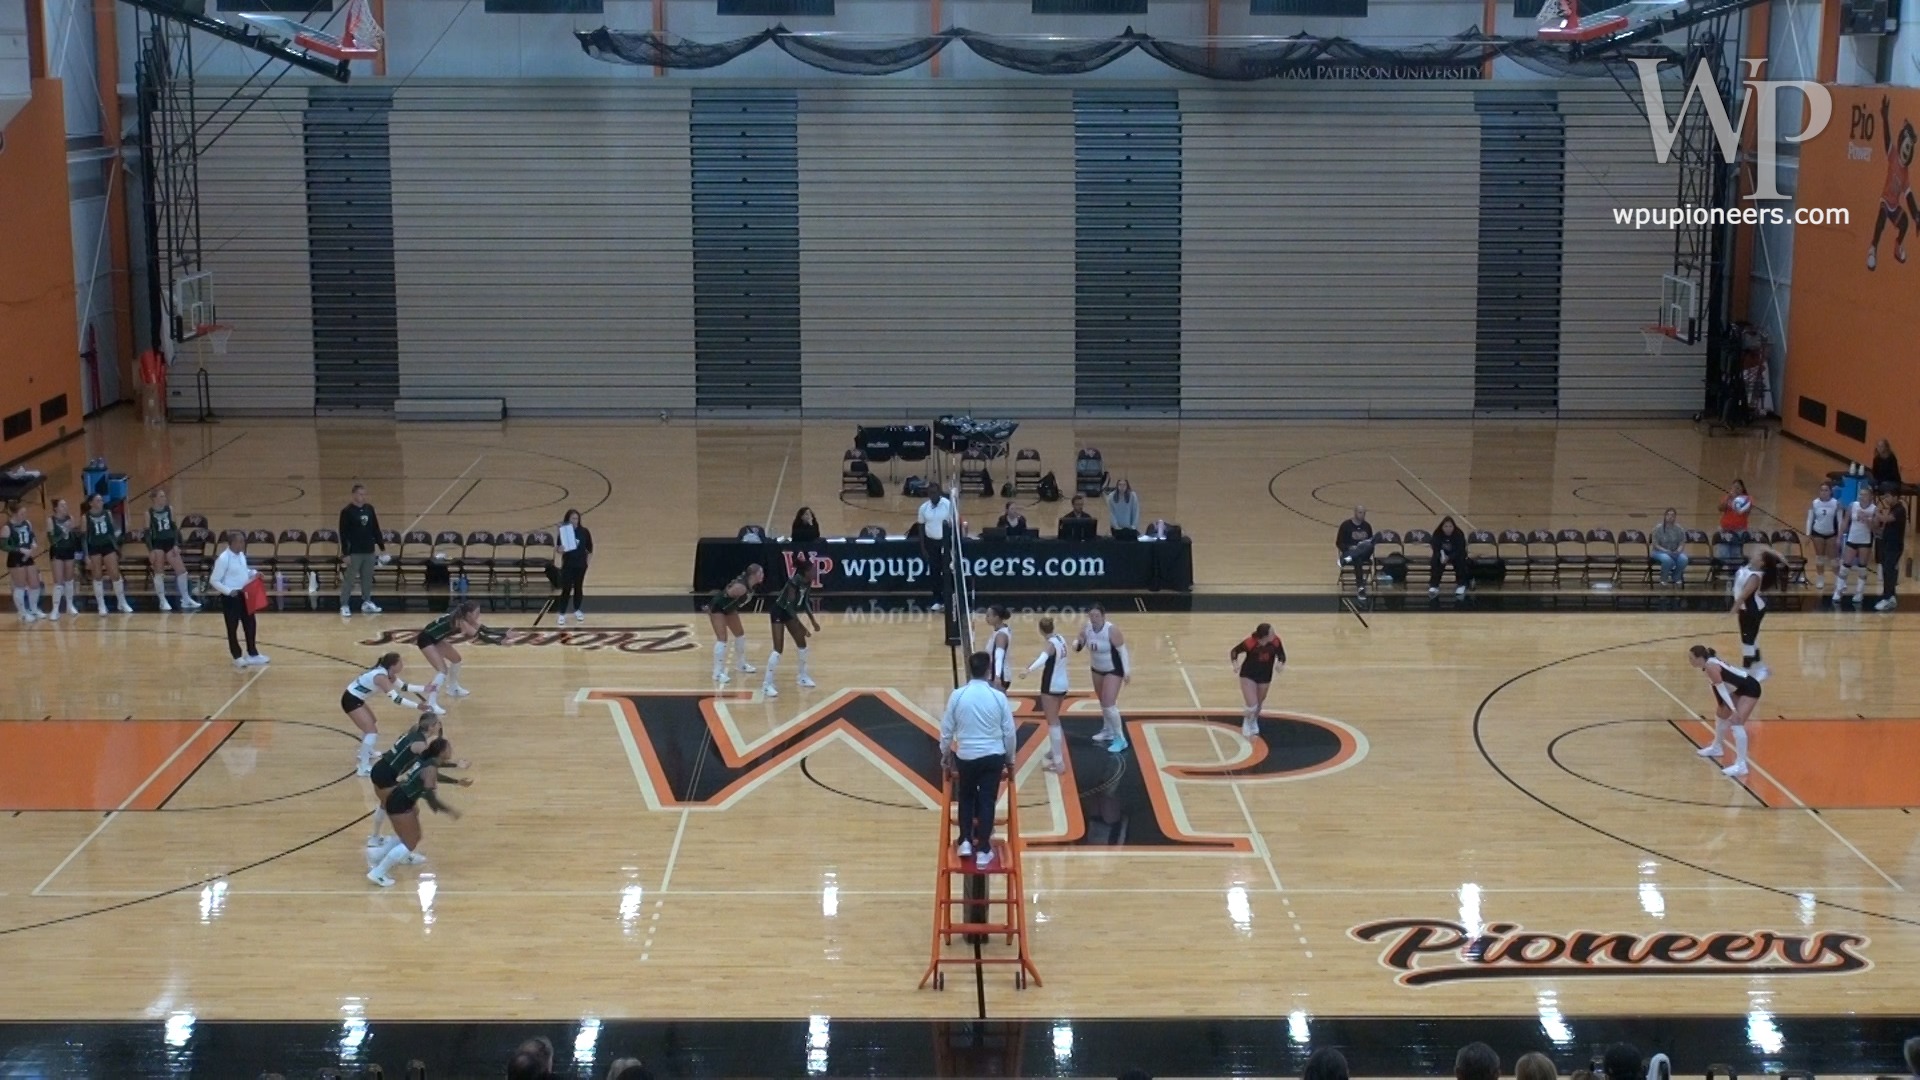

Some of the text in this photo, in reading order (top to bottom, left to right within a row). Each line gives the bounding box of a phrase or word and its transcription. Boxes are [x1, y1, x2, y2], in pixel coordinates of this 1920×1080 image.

[1316, 65, 1391, 79] PATERSON
[1395, 65, 1483, 79] UNIVERSITY
[1849, 103, 1874, 141] Pio
[1347, 917, 1874, 988] Pioneers
